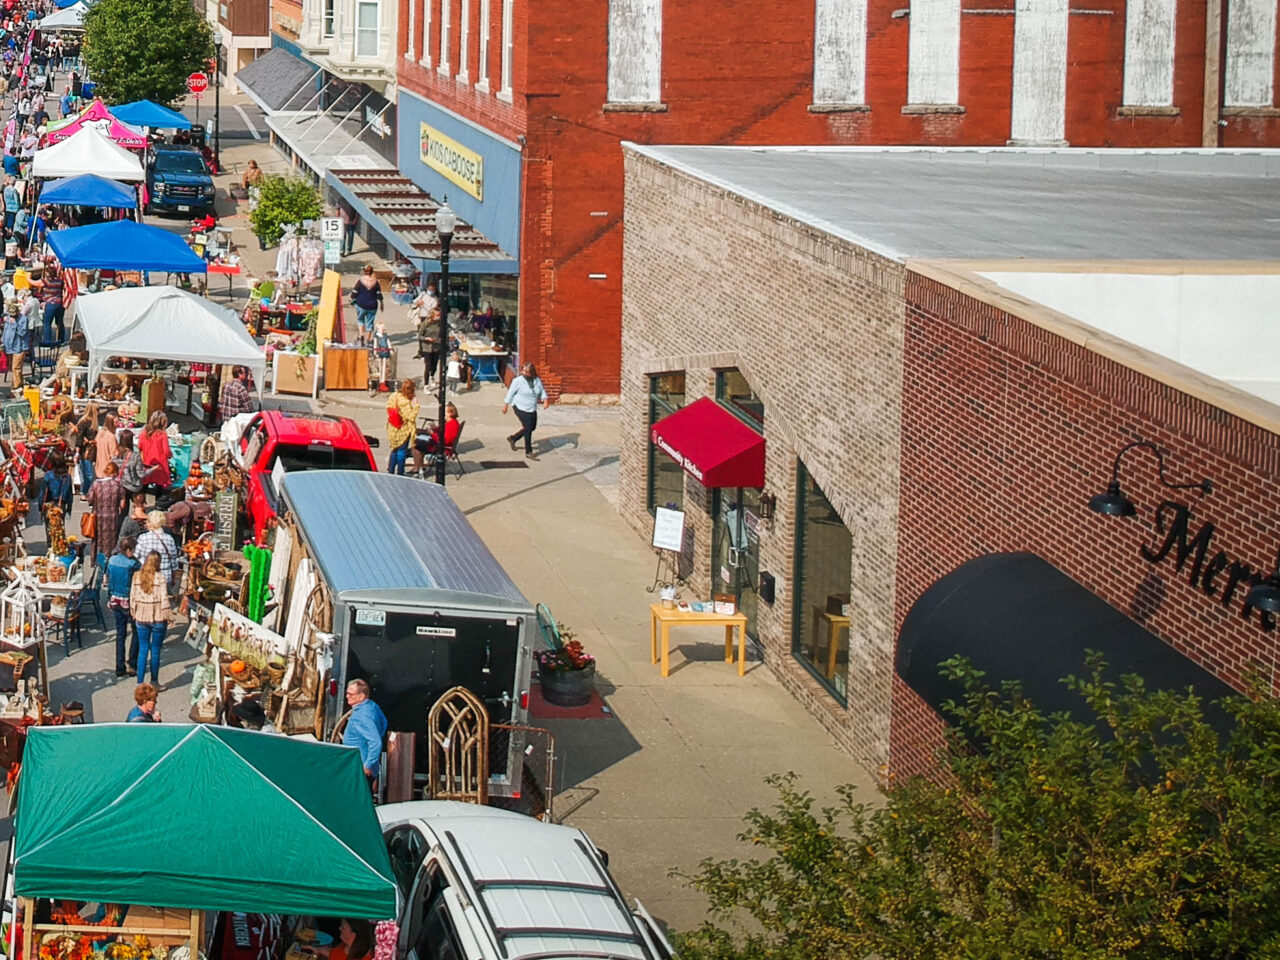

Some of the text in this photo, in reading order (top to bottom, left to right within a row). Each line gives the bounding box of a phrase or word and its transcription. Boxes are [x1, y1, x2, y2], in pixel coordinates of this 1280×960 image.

[188, 78, 207, 87] STOP
[429, 137, 476, 185] KIDS CABOOSE
[324, 220, 339, 231] 15
[657, 436, 684, 467] Community
[684, 456, 703, 481] Kitchen
[218, 495, 233, 538] FRESH
